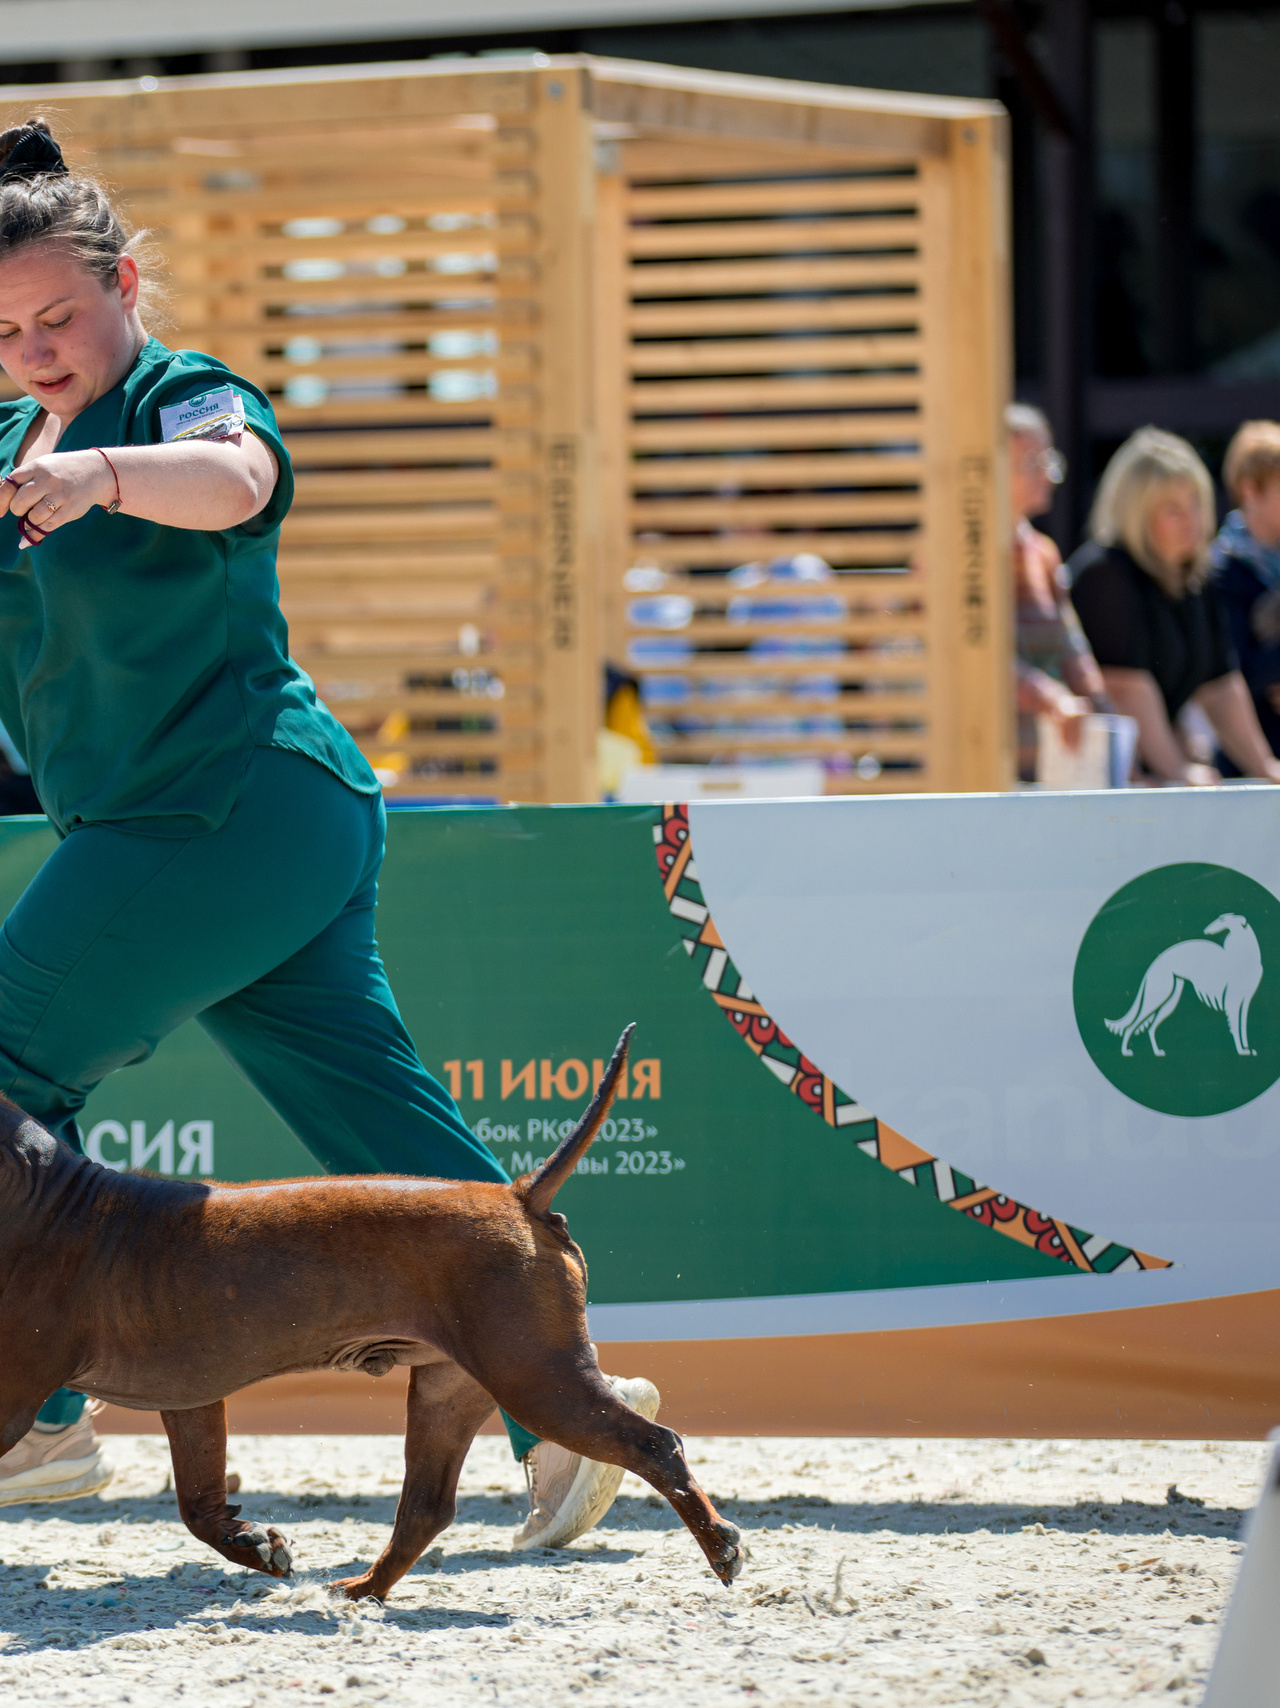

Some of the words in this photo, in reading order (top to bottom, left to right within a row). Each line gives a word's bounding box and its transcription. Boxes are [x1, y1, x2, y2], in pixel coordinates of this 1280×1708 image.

[179, 403, 219, 421] РОССИЯ
[443, 1060, 484, 1100] 11
[472, 1117, 521, 1142] бок
[593, 1118, 658, 1143] 023»
[77, 1119, 214, 1175] СИЯ
[615, 1151, 686, 1175] 2023»
